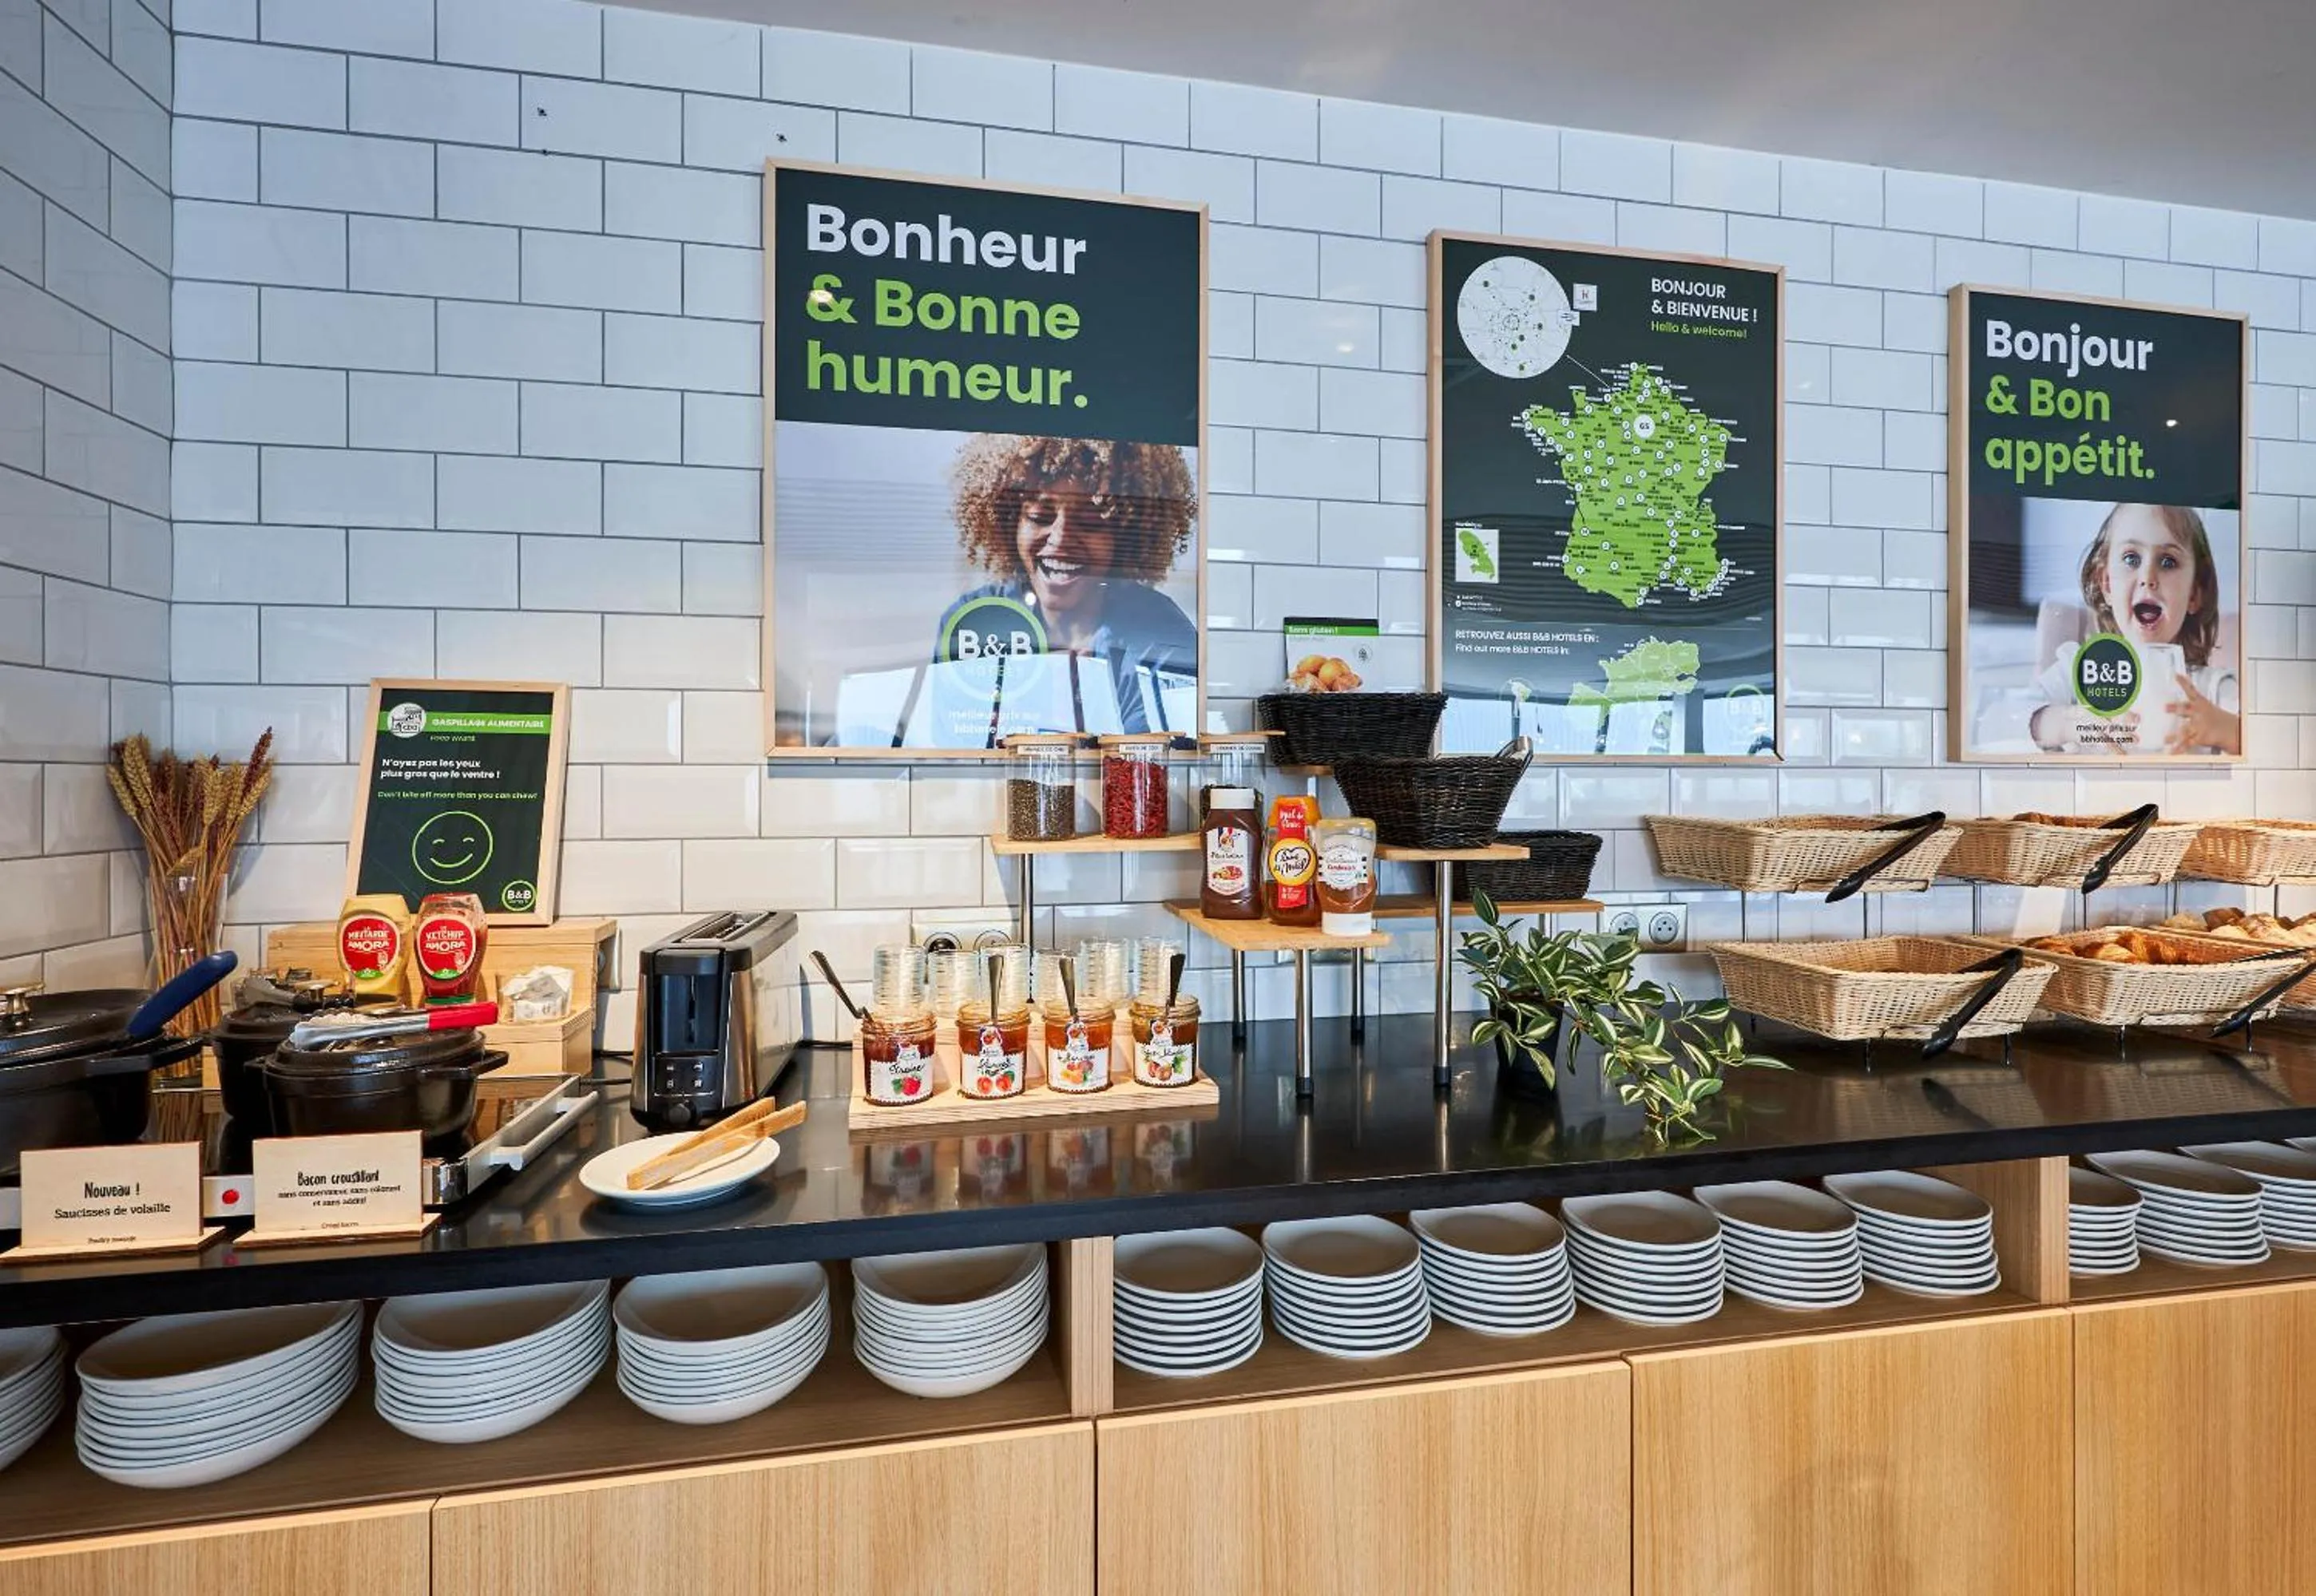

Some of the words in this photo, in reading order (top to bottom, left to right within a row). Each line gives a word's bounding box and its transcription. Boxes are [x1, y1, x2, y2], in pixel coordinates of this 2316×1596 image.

[807, 204, 1086, 275] Bonheur
[1652, 278, 1726, 299] BONJOUR
[806, 274, 858, 324] &
[875, 279, 1081, 340] Bonne
[1652, 299, 1664, 314] &
[1667, 300, 1749, 322] BIENVENUE
[1753, 308, 1758, 323] !
[1651, 321, 1679, 333] Hello
[1681, 324, 1690, 334] &
[1692, 326, 1747, 339] welcome!
[1986, 320, 2153, 377] Bonjour
[807, 339, 1088, 408] humeur.
[1985, 375, 2018, 414] &
[2029, 378, 2111, 422] Bon
[1985, 433, 2155, 485] appétit.
[958, 629, 1033, 659] B&B
[1455, 629, 1505, 640] RETROUVEZ
[1506, 631, 1531, 640] AUSSI
[1533, 632, 1550, 641] B&B
[1552, 633, 1583, 643] HOTELS
[1455, 644, 1473, 652] Find
[2083, 659, 2133, 684] B&B
[2088, 687, 2127, 697] HOTELS
[382, 758, 417, 769] N'ayez
[418, 760, 438, 769] pas
[455, 760, 481, 770] yeux
[380, 770, 403, 779] plus
[404, 771, 427, 780] gros
[429, 771, 449, 780] que
[450, 770, 460, 779] le
[462, 770, 495, 779] ventre
[478, 792, 494, 801] you
[507, 889, 532, 900] B&B
[347, 941, 390, 952] AMORA
[425, 941, 466, 952] AMORA
[298, 1170, 327, 1186] Bacon
[85, 1182, 130, 1198] Nouveau
[136, 1182, 140, 1195] !
[54, 1207, 110, 1219] Saucisses
[113, 1205, 128, 1215] de
[131, 1202, 171, 1214] volaille
